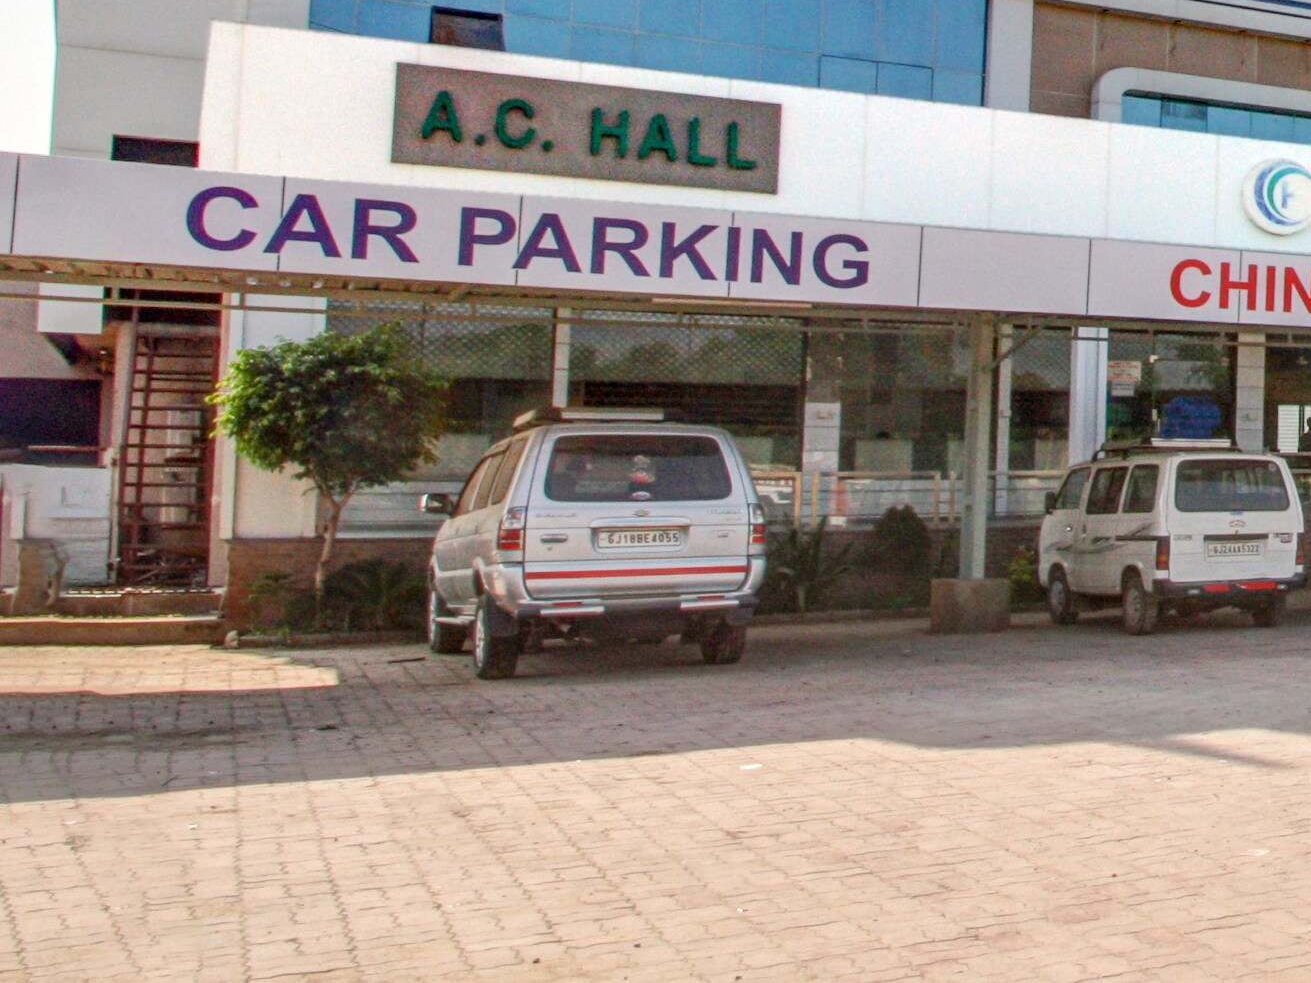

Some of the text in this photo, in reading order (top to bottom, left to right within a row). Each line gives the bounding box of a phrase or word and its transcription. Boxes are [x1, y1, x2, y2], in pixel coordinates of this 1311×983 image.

[420, 91, 757, 170] A.C. HALL
[186, 186, 871, 289] CAR PARKING
